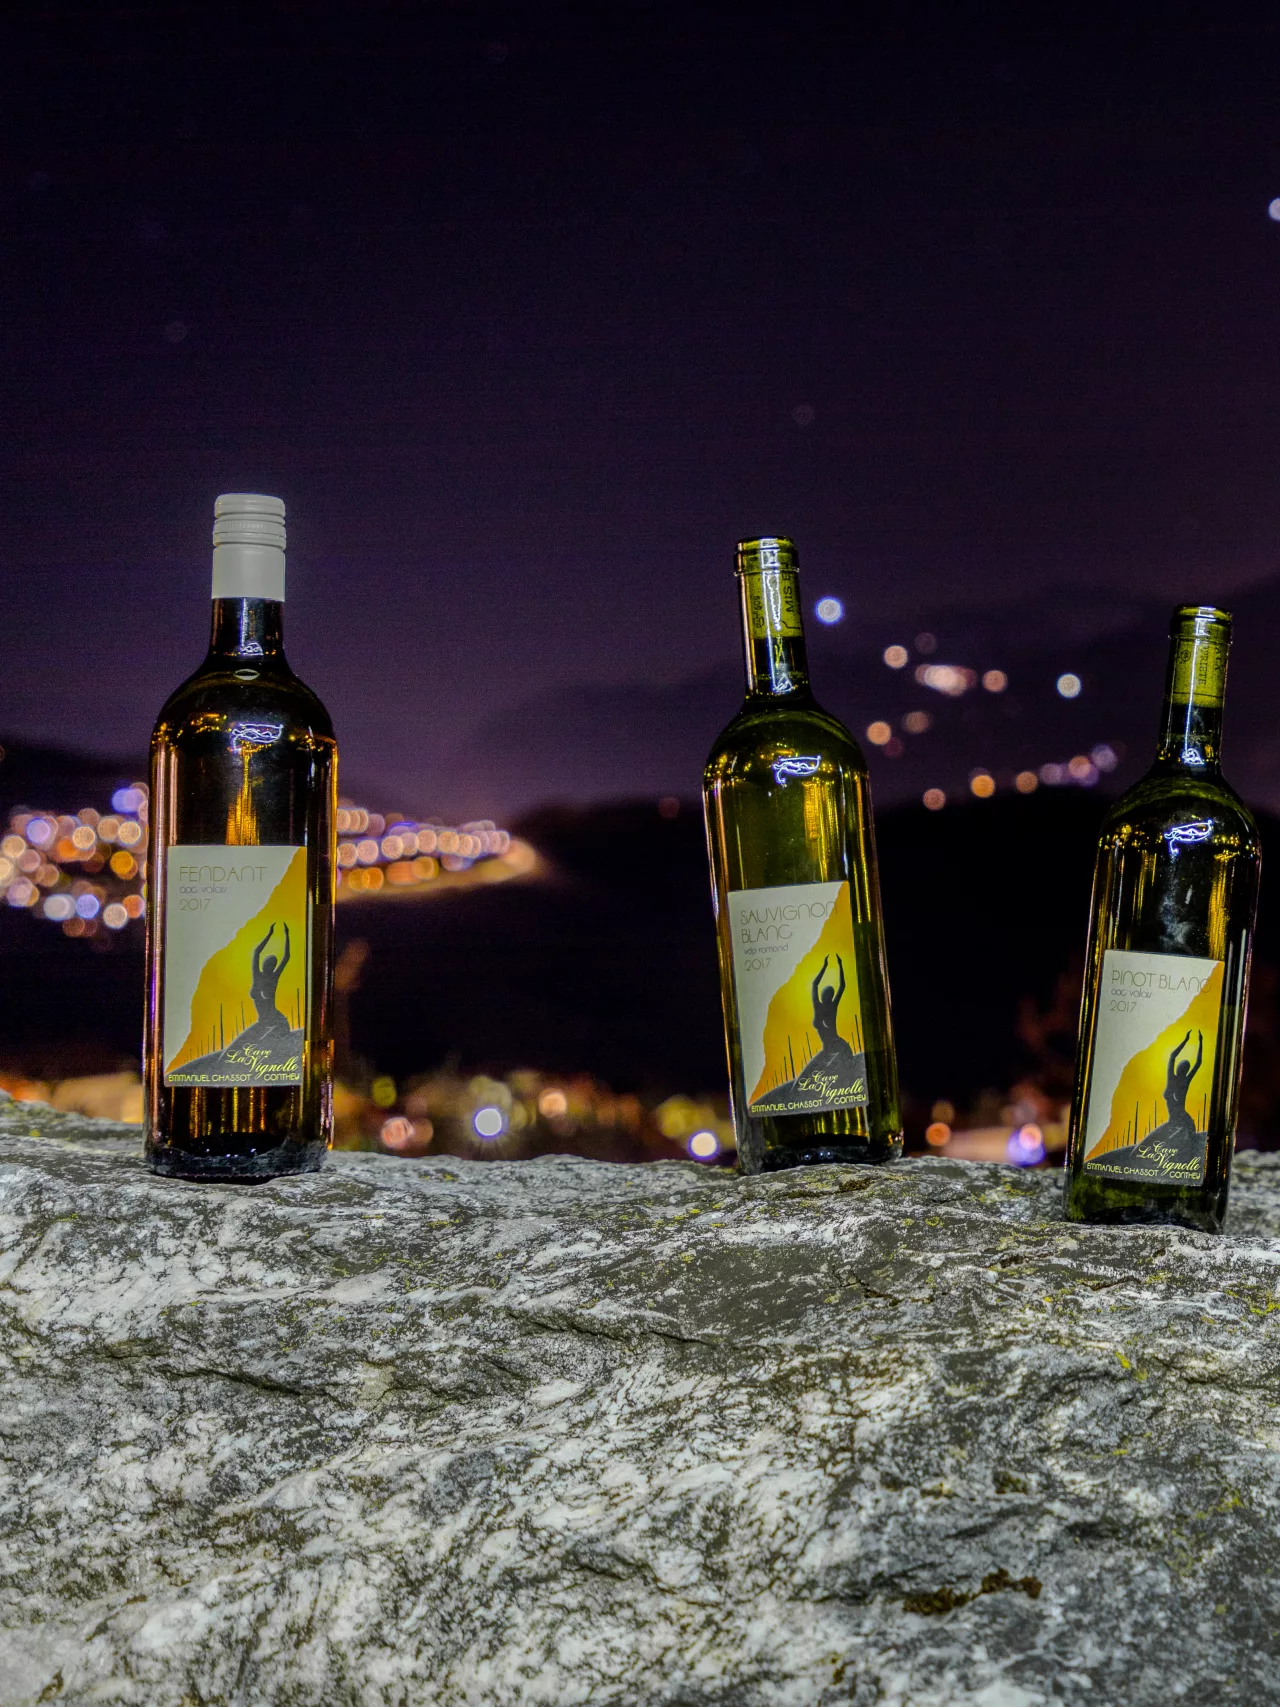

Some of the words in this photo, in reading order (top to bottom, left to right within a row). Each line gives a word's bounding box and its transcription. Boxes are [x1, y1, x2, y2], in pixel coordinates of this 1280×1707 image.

[783, 586, 795, 612] MIS
[179, 865, 269, 882] FENDANT
[179, 898, 211, 911] 2017
[740, 901, 838, 926] SAUVIGNON
[741, 924, 793, 944] BLANC
[758, 943, 789, 954] romand
[744, 958, 771, 971] 2017
[1112, 969, 1156, 988] PINOT
[1158, 974, 1212, 993] BLANC
[1109, 1000, 1137, 1013] 2017
[225, 1050, 245, 1063] La
[243, 1043, 272, 1057] Cave
[168, 1074, 210, 1082] EMMANUEL
[212, 1074, 252, 1082] CHASSOT
[812, 1070, 838, 1082] Cave
[798, 1078, 817, 1091] La
[751, 1104, 787, 1113] EMMANUEL
[788, 1099, 823, 1110] CHASSOT
[1136, 1145, 1154, 1159] La
[1152, 1140, 1178, 1153] Cave
[1086, 1162, 1123, 1174] EMMANUEL
[1123, 1166, 1159, 1177] CHASSOT
